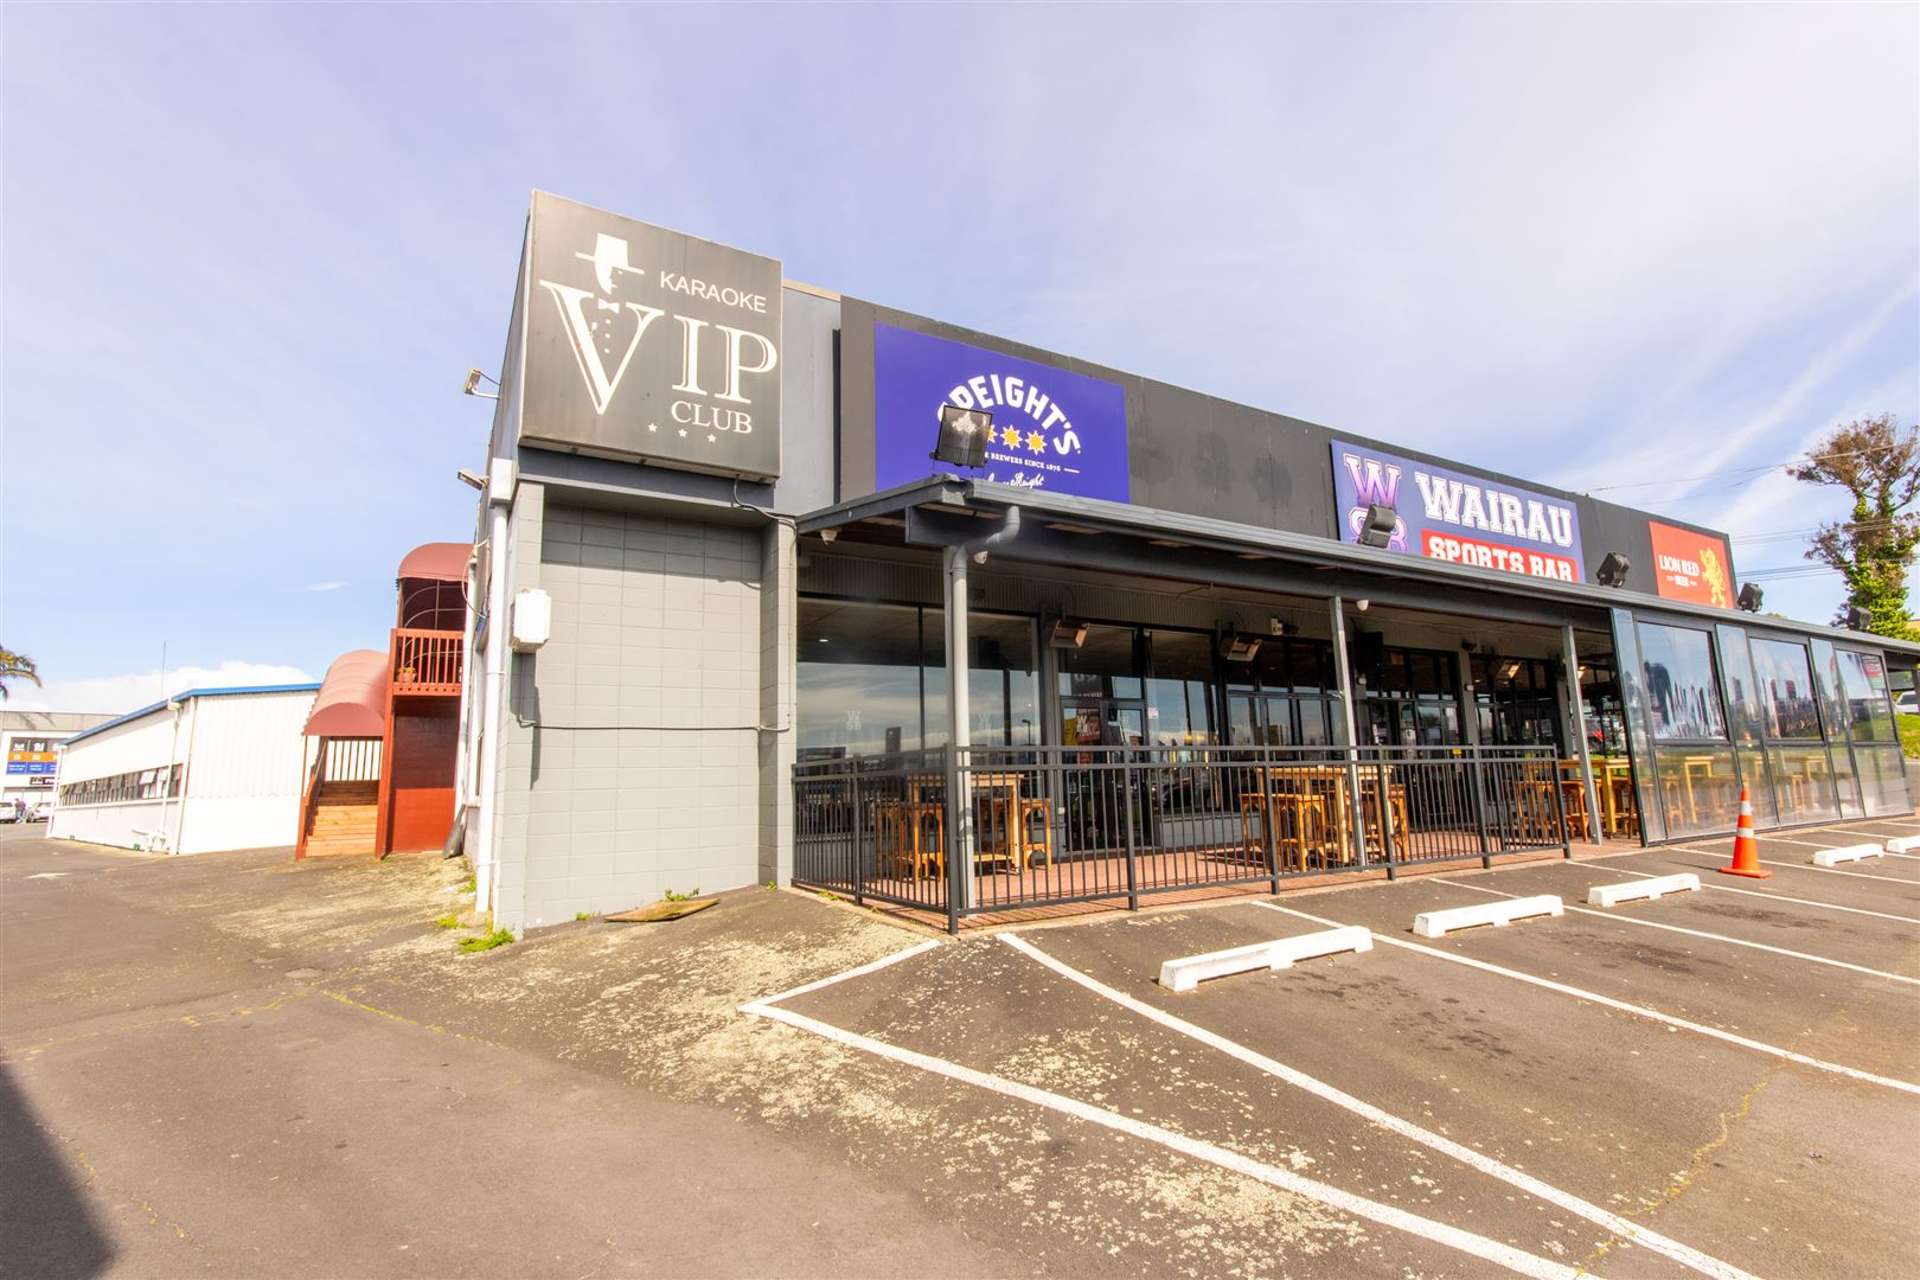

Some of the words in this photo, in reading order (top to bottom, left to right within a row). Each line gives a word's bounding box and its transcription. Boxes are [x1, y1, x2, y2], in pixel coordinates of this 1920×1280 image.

[659, 270, 767, 313] KARAOKE
[540, 279, 778, 415] VIP
[671, 400, 753, 434] CLUB
[937, 374, 1081, 456] PEIGHT'S
[990, 452, 1023, 465] BREWERS
[1024, 458, 1045, 469] SINCE
[1343, 453, 1401, 507] W
[1414, 471, 1574, 548] WAIRAU
[1428, 536, 1525, 574] SPORTS
[1530, 554, 1573, 582] BAR
[1681, 559, 1700, 577] RED
